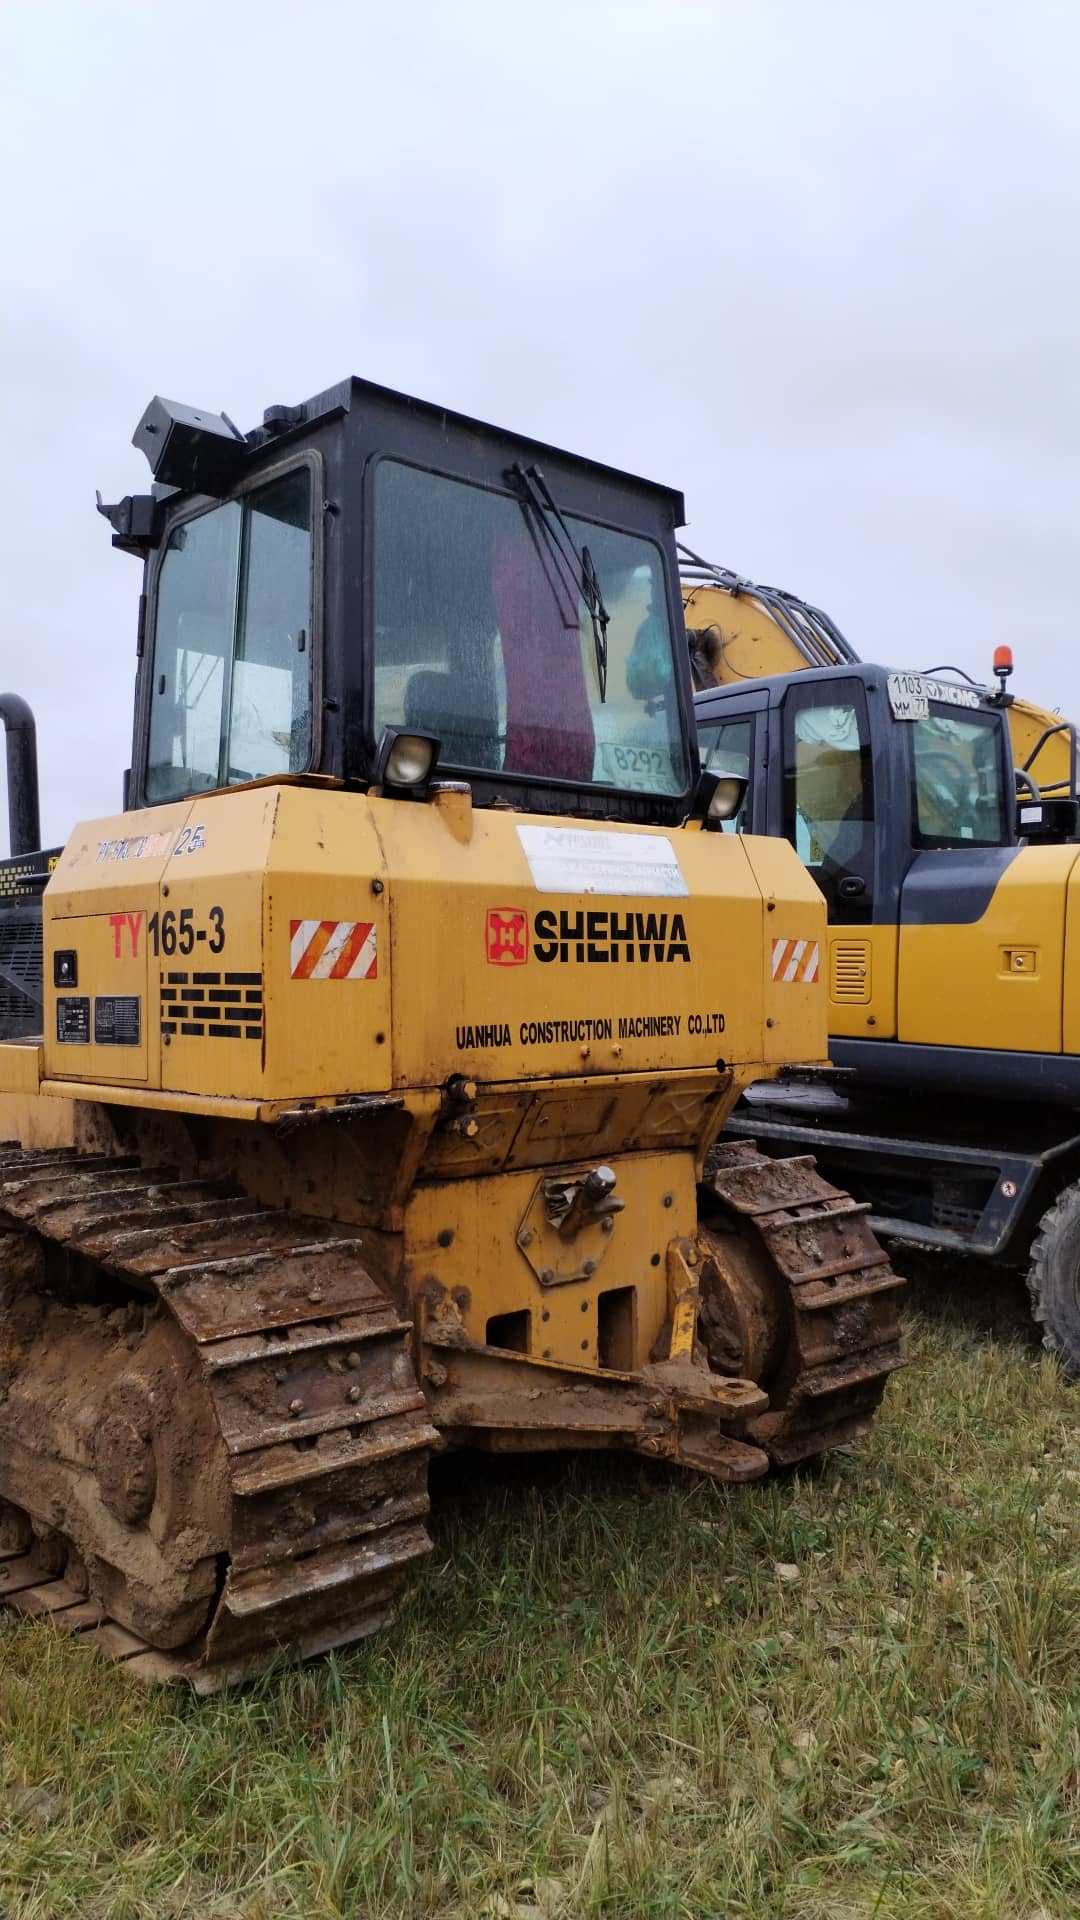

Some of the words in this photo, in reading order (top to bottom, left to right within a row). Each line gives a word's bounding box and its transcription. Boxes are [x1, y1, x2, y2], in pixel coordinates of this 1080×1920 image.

[614, 746, 667, 775] 8292
[533, 910, 691, 963] SHEHWA
[455, 1023, 512, 1050] UANHUA
[519, 1019, 612, 1045] CONSTRUCTION
[618, 1015, 681, 1039] MACHINERY
